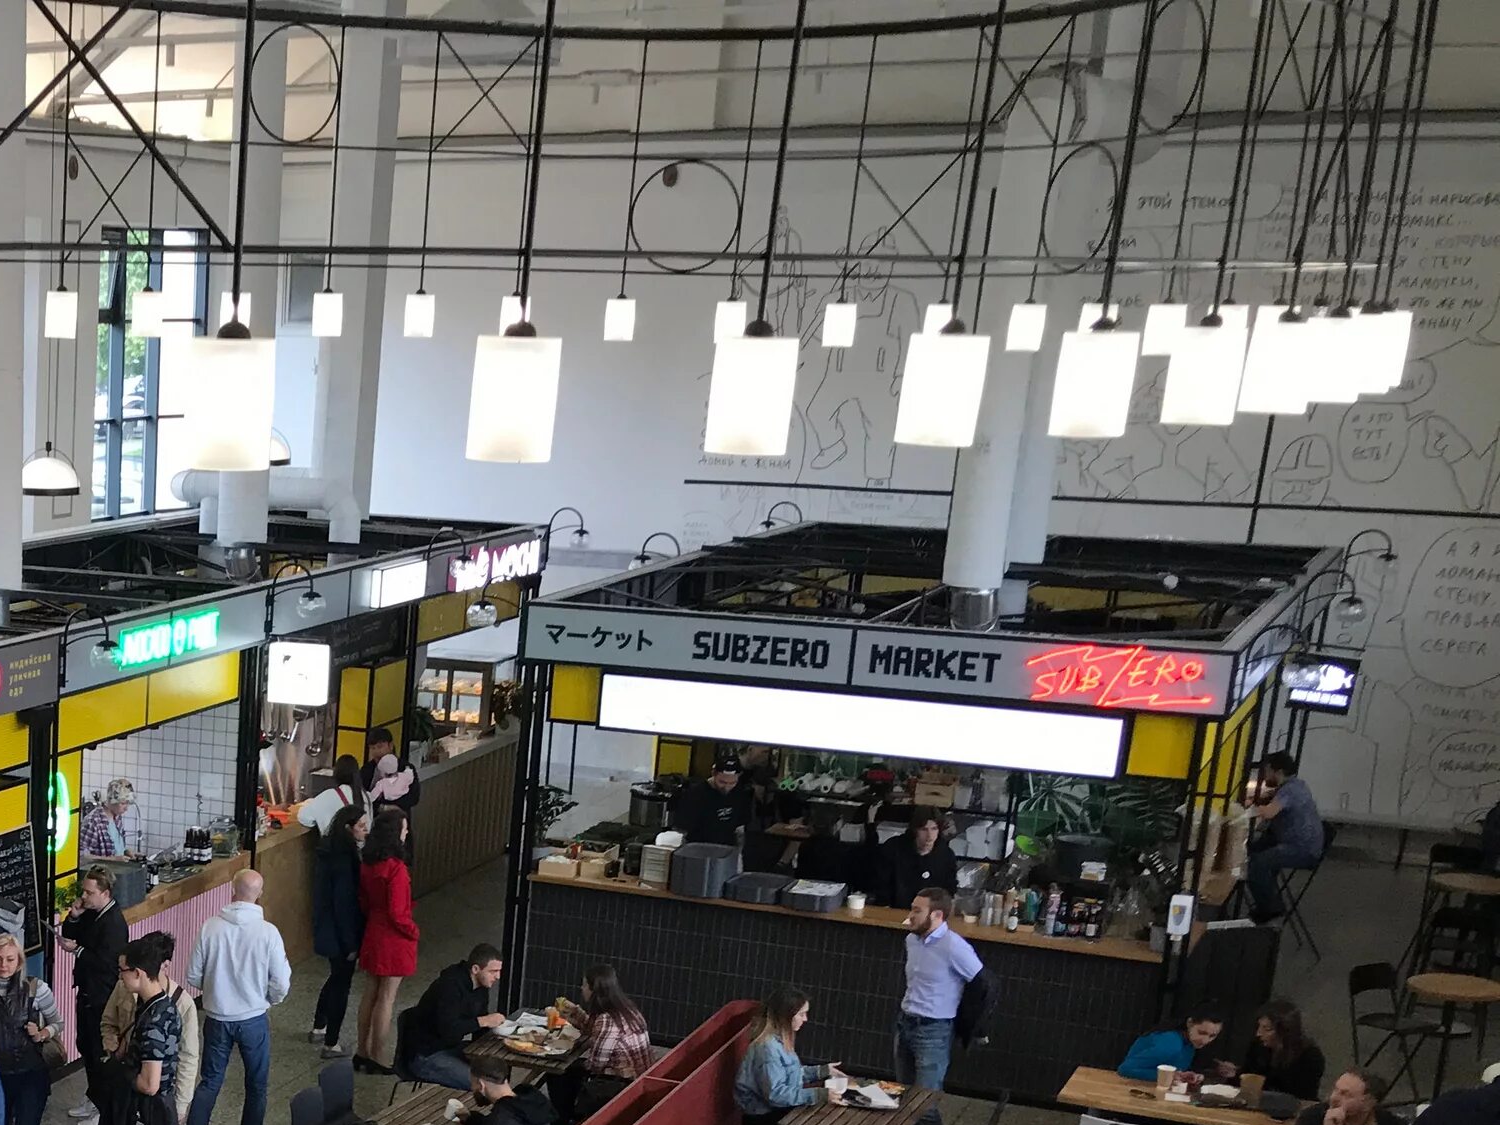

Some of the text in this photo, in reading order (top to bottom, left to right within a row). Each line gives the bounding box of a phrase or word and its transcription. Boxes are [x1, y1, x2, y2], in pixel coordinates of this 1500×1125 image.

[544, 621, 654, 653] マーケット
[690, 630, 1002, 685] SUBZERO MARKET
